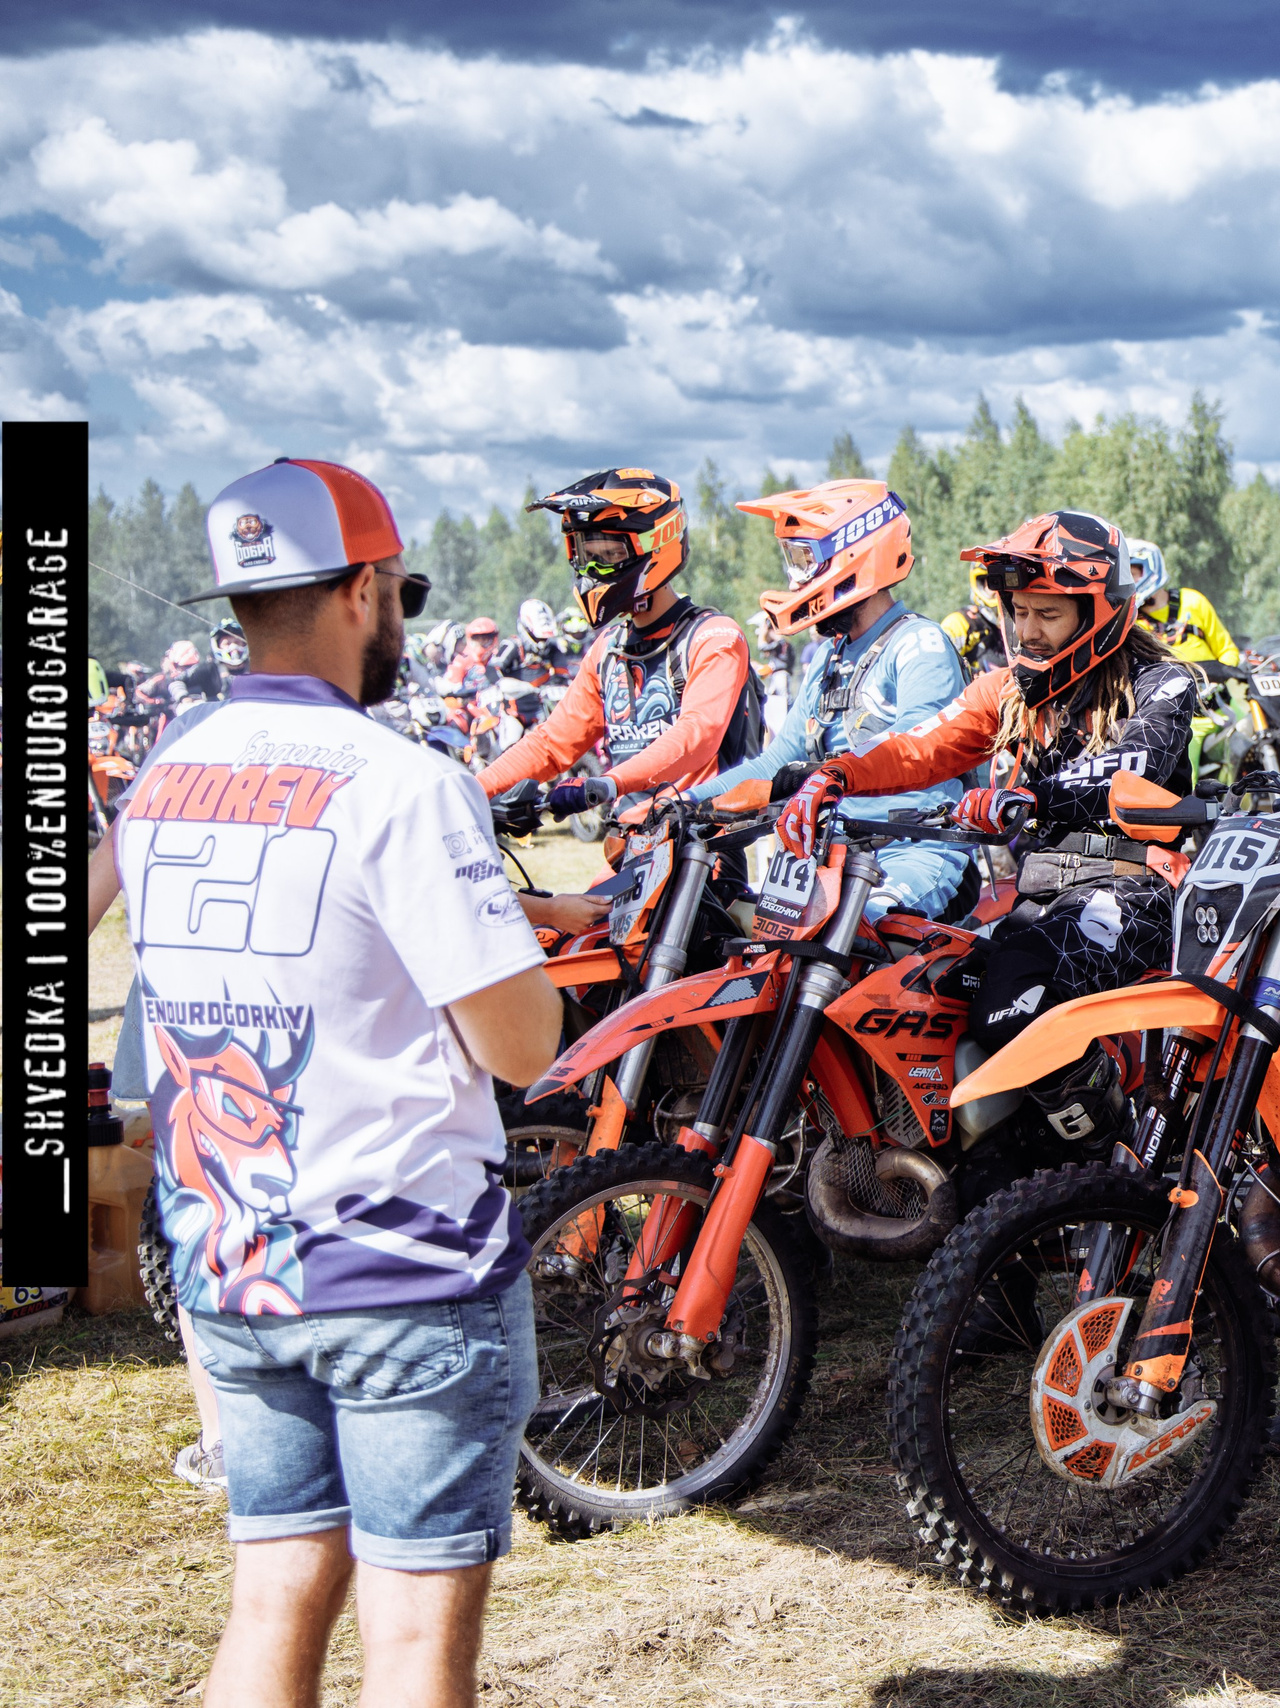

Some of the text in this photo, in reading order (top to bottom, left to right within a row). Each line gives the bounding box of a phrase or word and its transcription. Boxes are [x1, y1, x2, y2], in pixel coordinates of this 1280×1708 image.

[831, 500, 900, 553] 100%
[893, 627, 946, 669] 28
[609, 713, 677, 742] RAKEN
[1063, 778, 1112, 789] PLA
[1194, 836, 1266, 871] 015
[768, 850, 810, 892] 014
[759, 900, 802, 920] ROGOZHKIN
[853, 1007, 954, 1039] GAS
[987, 1006, 1021, 1025] UFO
